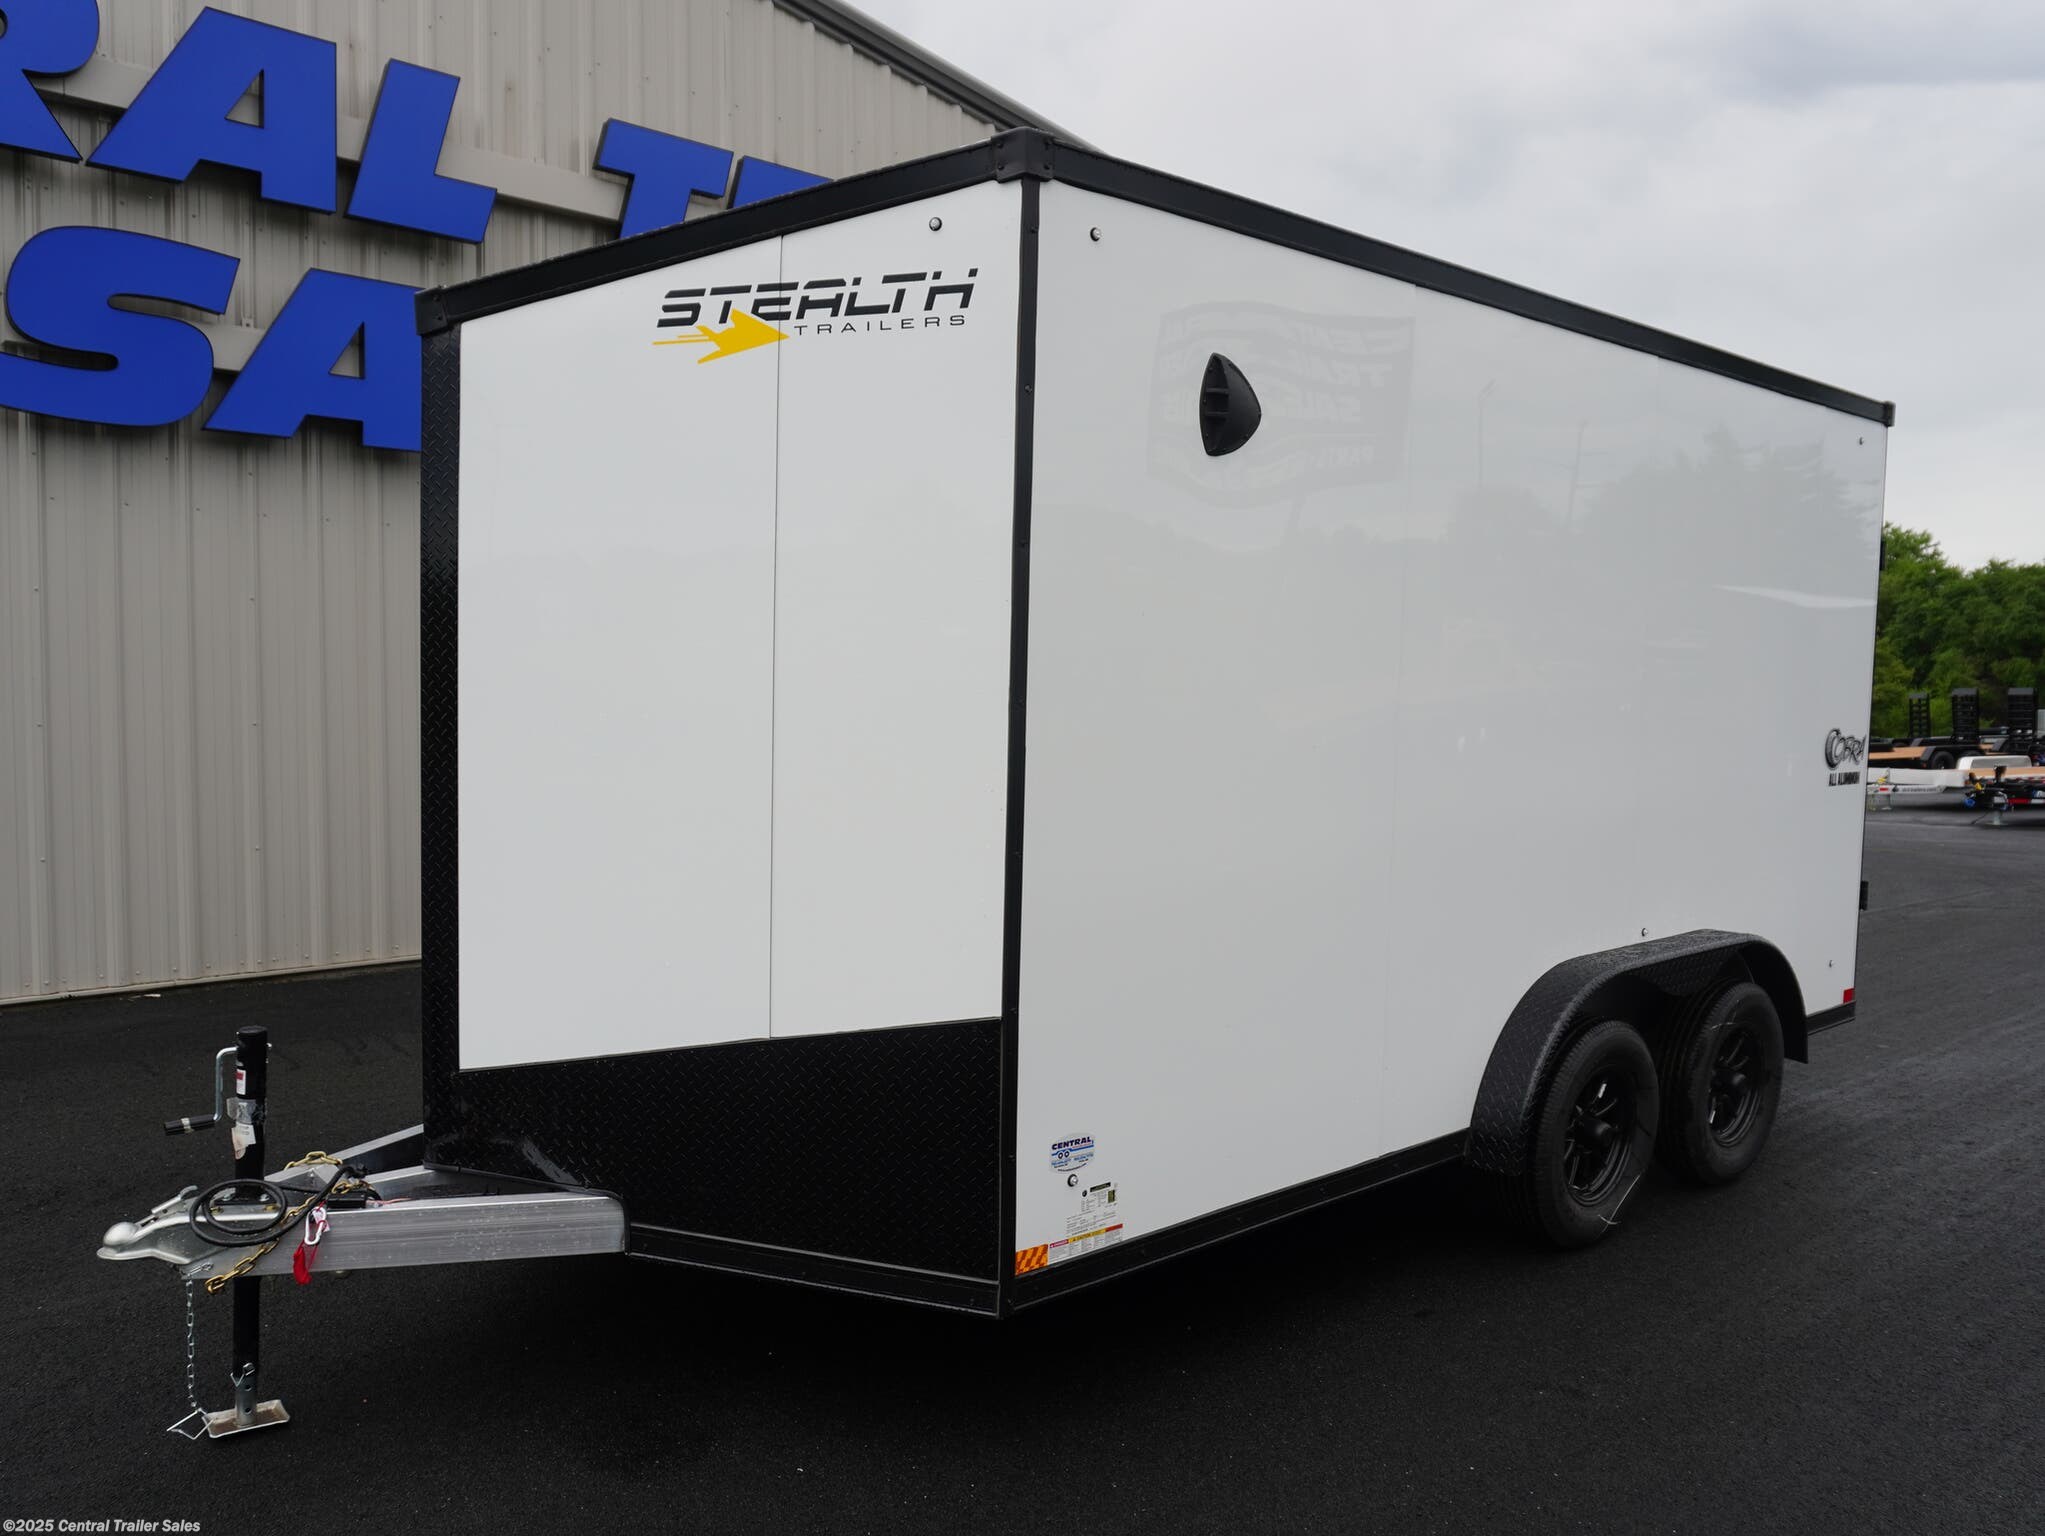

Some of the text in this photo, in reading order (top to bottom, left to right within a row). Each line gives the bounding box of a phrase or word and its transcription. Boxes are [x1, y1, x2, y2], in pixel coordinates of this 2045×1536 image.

[593, 117, 835, 240] T
[657, 267, 978, 328] STEALTH
[794, 314, 965, 336] TRAILERS
[1051, 1136, 1092, 1151] CENTRAL
